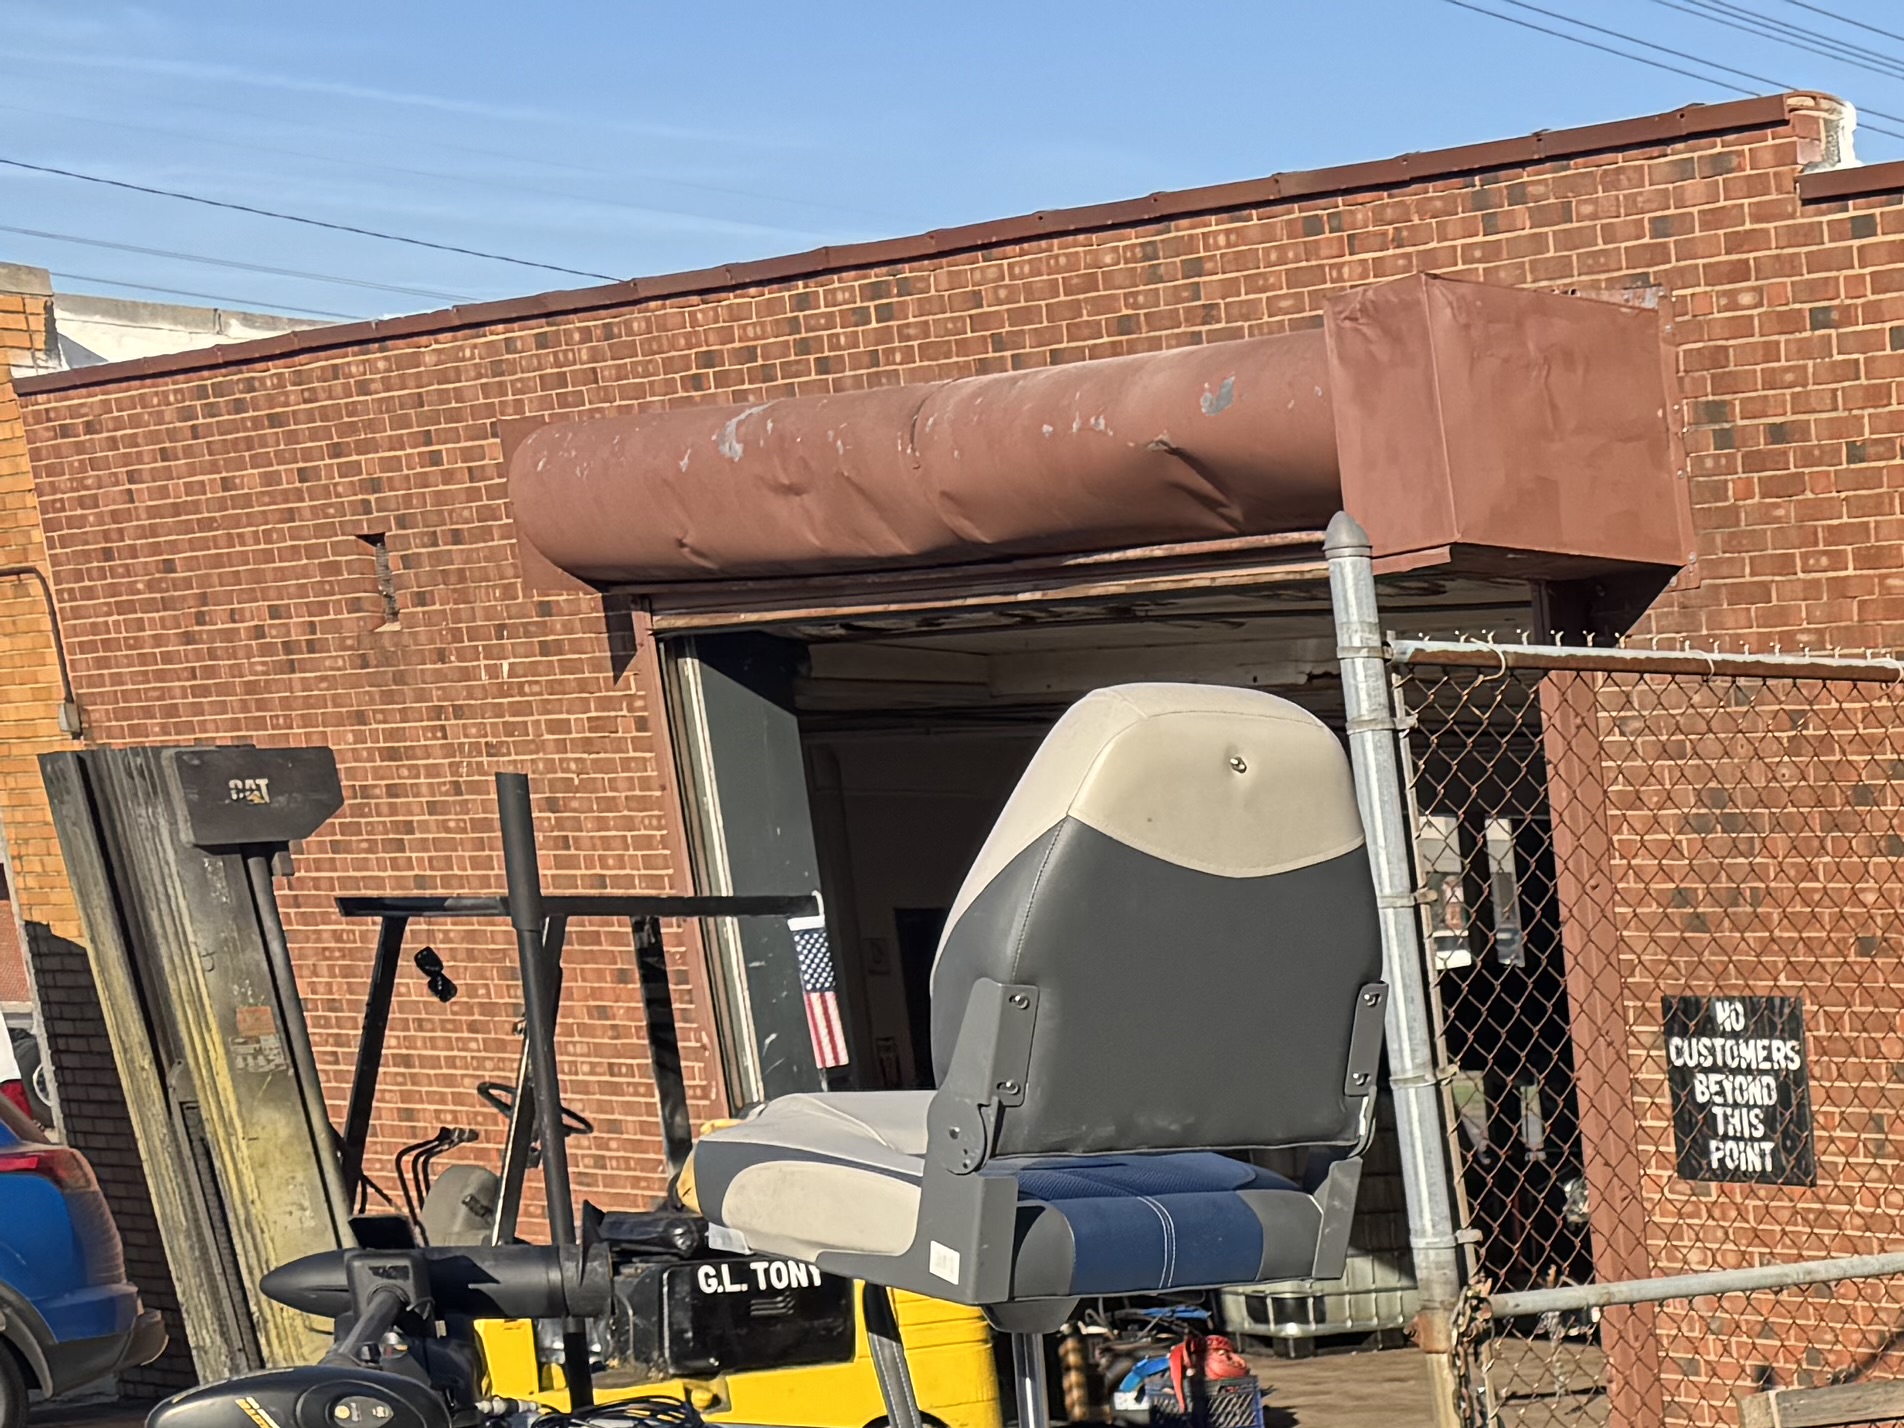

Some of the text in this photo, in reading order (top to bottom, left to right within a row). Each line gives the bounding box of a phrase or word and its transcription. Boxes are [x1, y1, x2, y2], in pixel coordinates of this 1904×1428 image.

[229, 778, 270, 804] CAT
[1715, 1000, 1745, 1032] NO
[1668, 1036, 1801, 1071] CUSTOMERS
[1694, 1072, 1778, 1106] BEYOND
[1711, 1106, 1765, 1138] THIS
[1709, 1140, 1775, 1172] POINT
[697, 1260, 822, 1294] G.L. TONY
